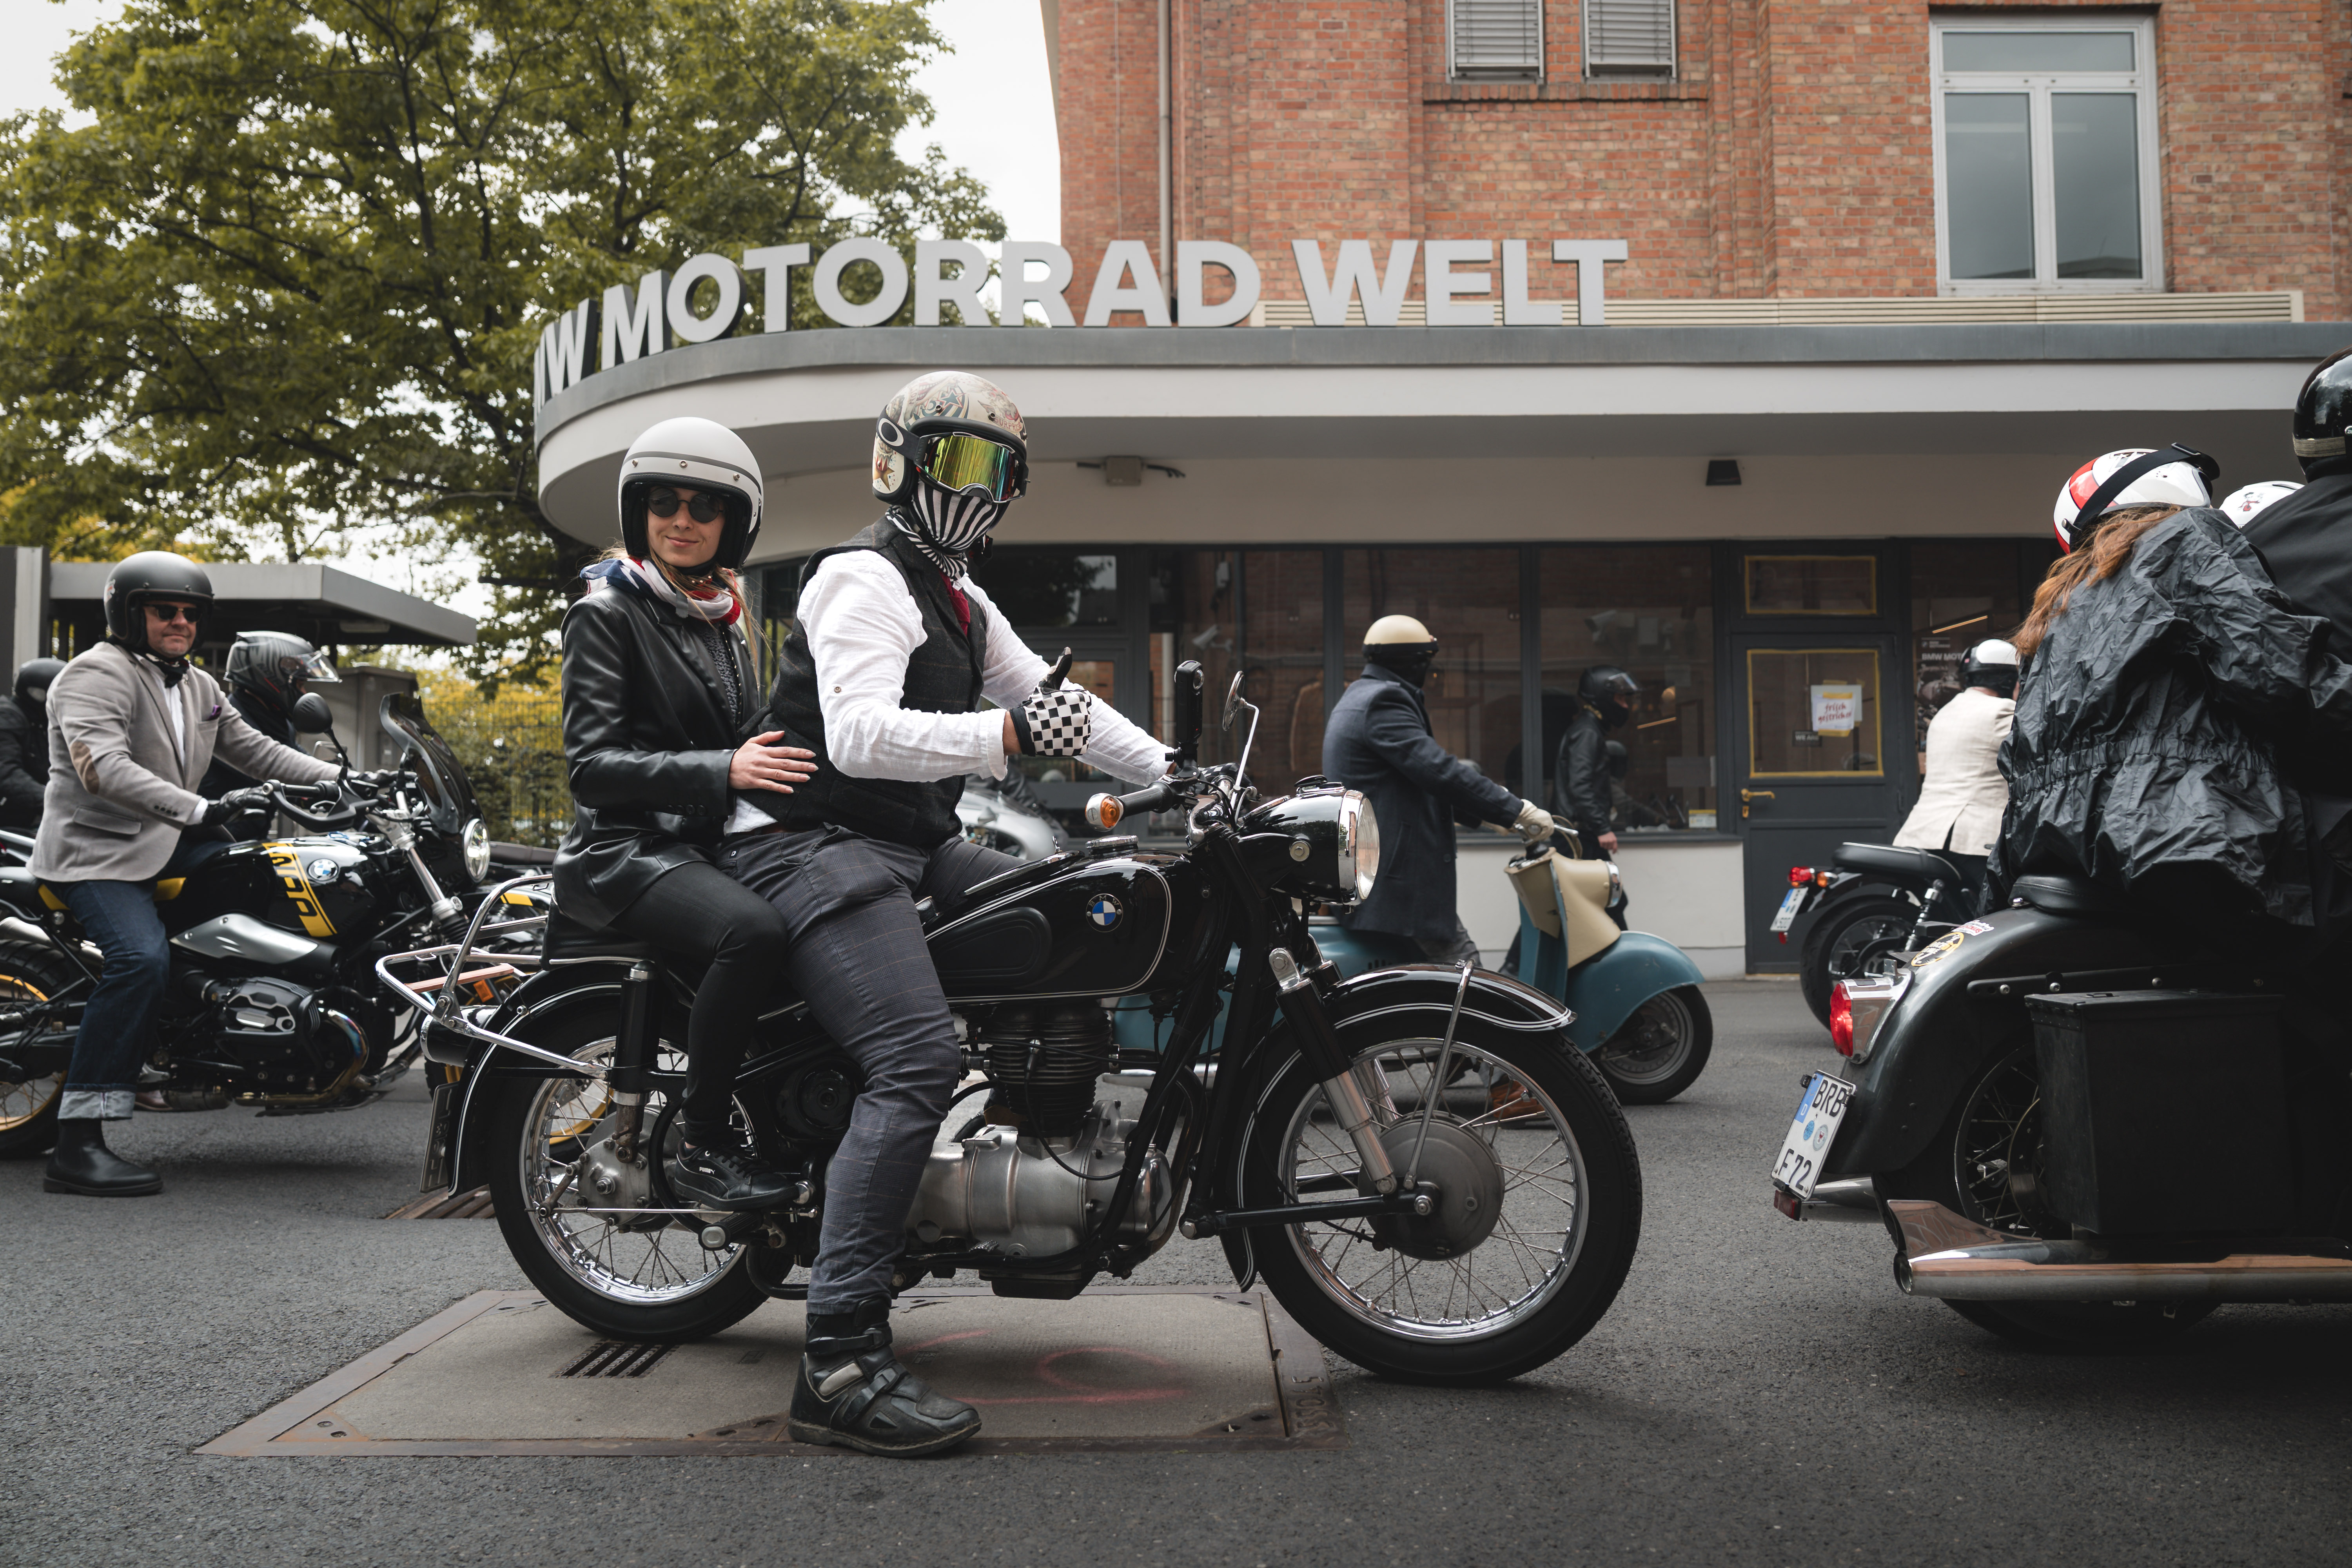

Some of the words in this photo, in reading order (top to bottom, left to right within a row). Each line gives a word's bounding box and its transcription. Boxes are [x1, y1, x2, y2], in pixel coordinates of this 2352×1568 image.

[601, 236, 1261, 371] MOTORRAD
[1291, 239, 1628, 326] WELT
[1089, 895, 1119, 907] BMW
[1800, 1103, 1808, 1116] D
[1812, 1080, 1847, 1117] BRB
